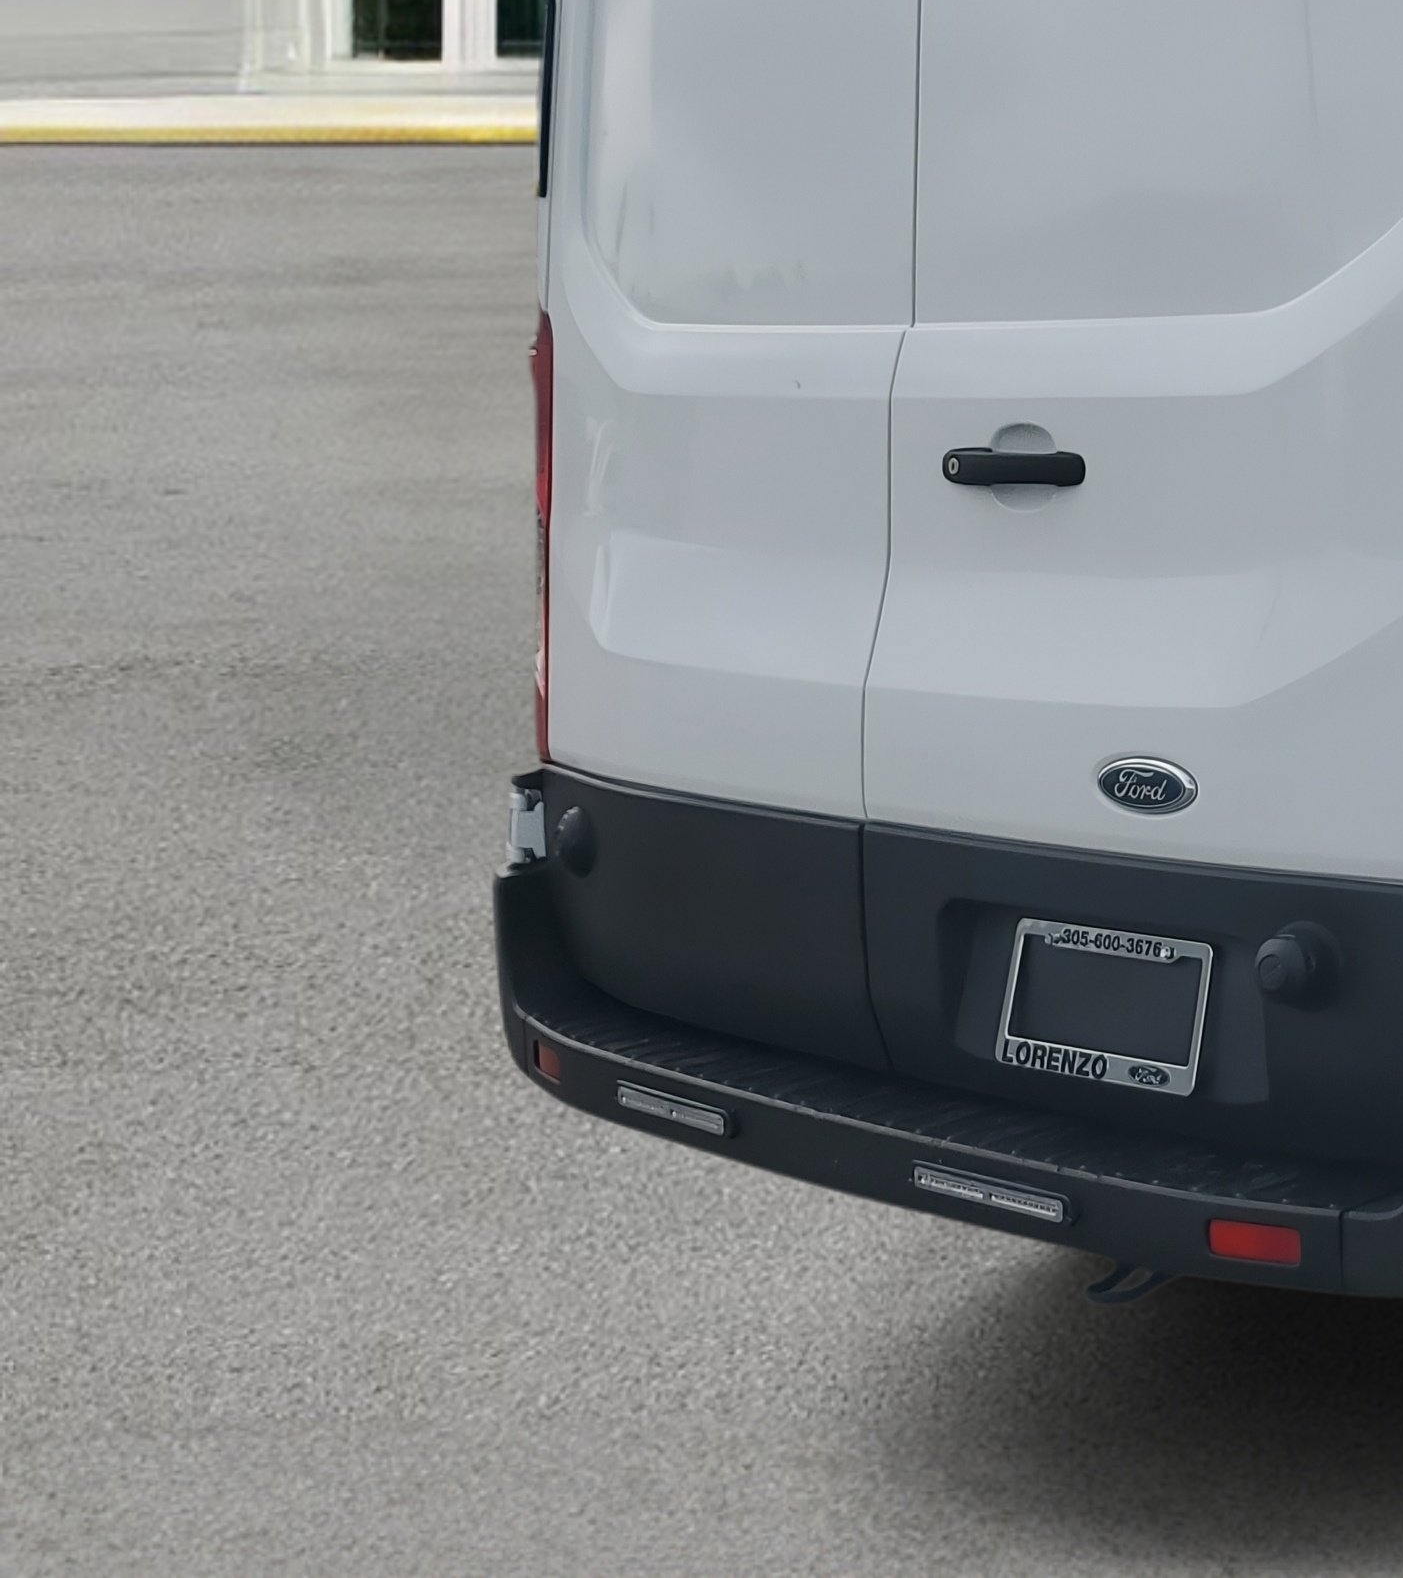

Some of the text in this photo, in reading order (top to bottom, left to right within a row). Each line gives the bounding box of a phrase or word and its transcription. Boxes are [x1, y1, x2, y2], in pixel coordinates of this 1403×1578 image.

[1114, 768, 1168, 801] Ford
[1062, 928, 1162, 958] 305-600-3676
[1001, 1038, 1108, 1080] LORENZO
